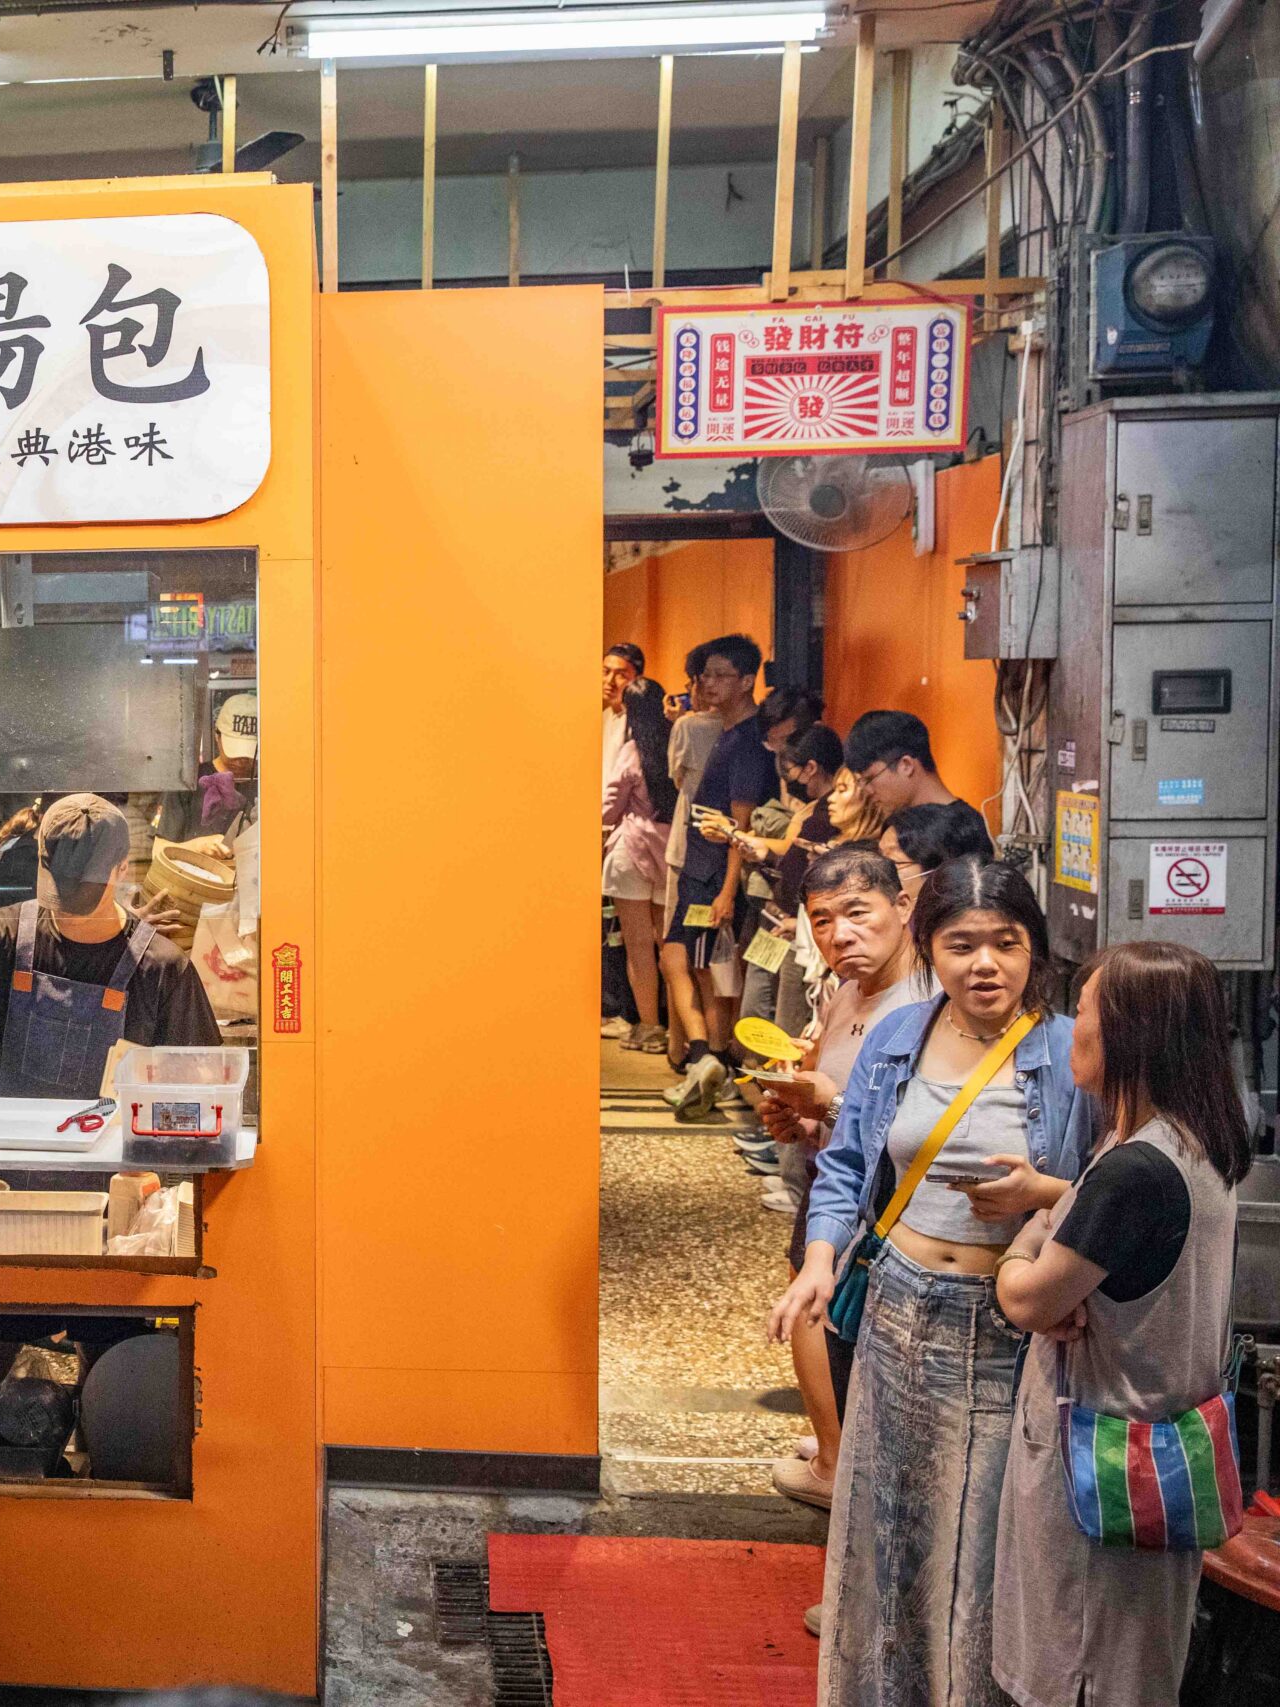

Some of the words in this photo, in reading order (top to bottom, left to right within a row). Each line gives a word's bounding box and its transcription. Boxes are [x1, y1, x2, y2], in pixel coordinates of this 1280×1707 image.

[763, 323, 865, 352] 發財符
[798, 395, 825, 419] 發
[280, 969, 295, 1019] 開工大吉
